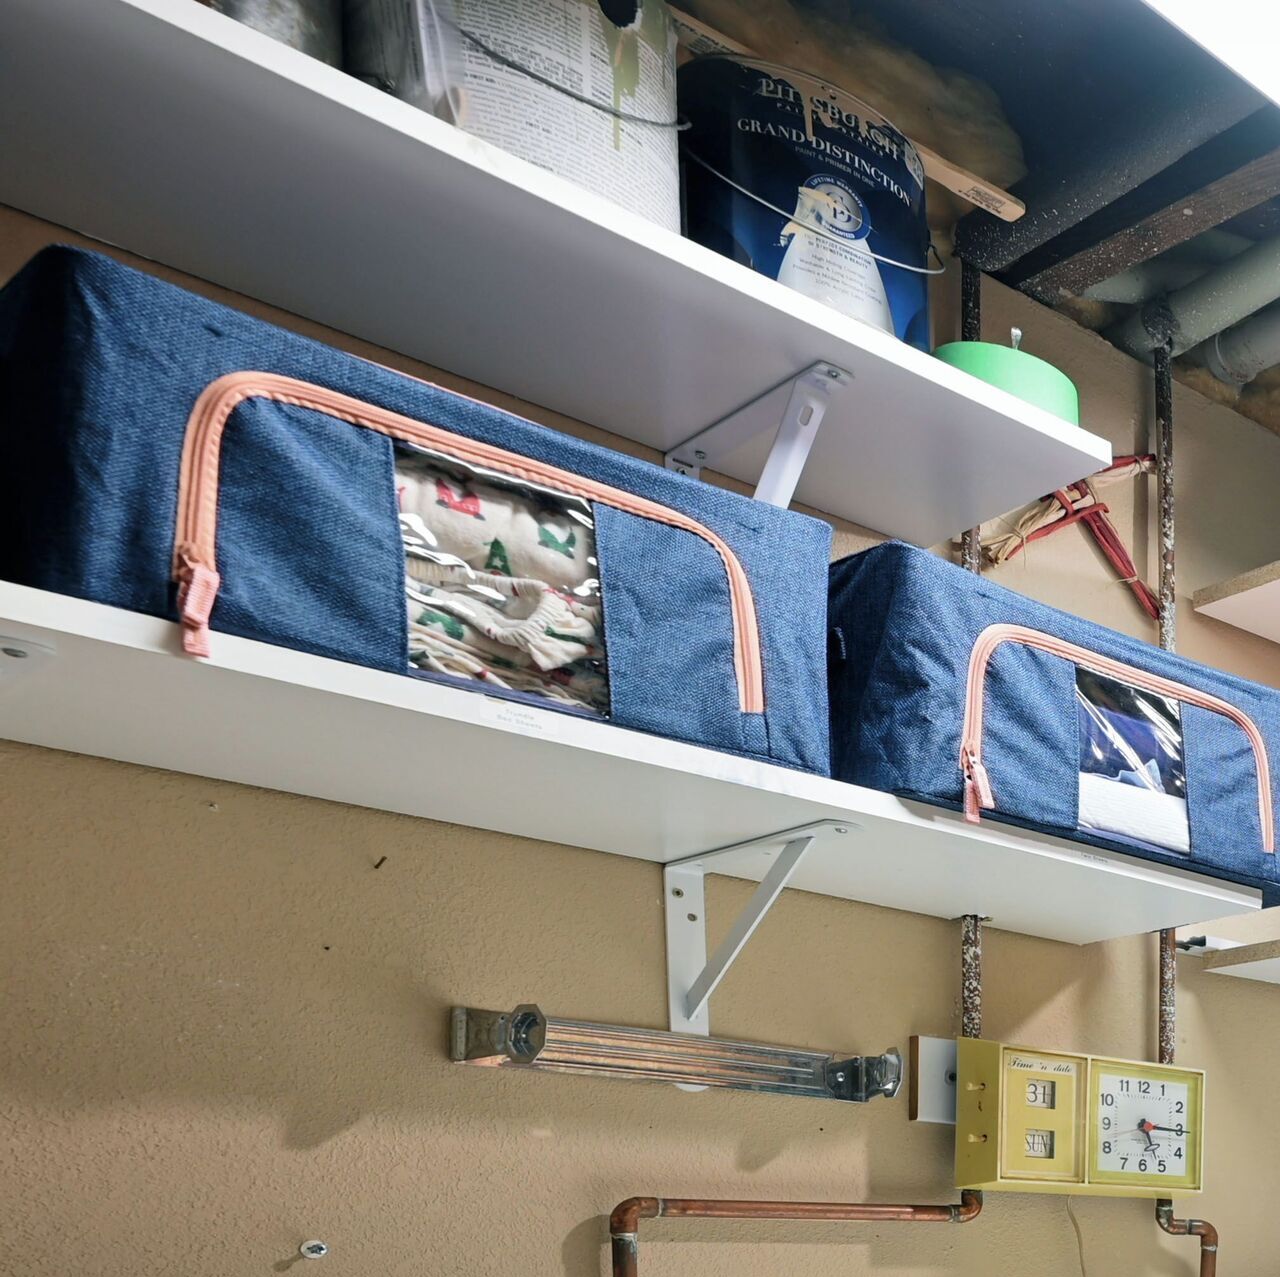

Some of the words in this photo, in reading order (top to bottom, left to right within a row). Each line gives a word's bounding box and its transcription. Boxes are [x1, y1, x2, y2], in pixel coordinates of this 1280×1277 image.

[737, 117, 806, 143] GRAND
[812, 136, 911, 207] DISTINCTION
[1026, 1083, 1048, 1104] 31
[1120, 1080, 1129, 1092] 11
[1138, 1081, 1150, 1094] 12
[1161, 1084, 1165, 1096] 1
[1100, 1093, 1114, 1106] 10
[1176, 1101, 1183, 1113] 2
[1102, 1117, 1111, 1130] 9
[1176, 1124, 1183, 1136] 3
[1025, 1134, 1048, 1153] SUN
[1102, 1141, 1112, 1153] 8
[1174, 1147, 1183, 1159] 4
[1120, 1157, 1128, 1170] 7
[1139, 1159, 1147, 1172] 6
[1158, 1160, 1166, 1172] 5
